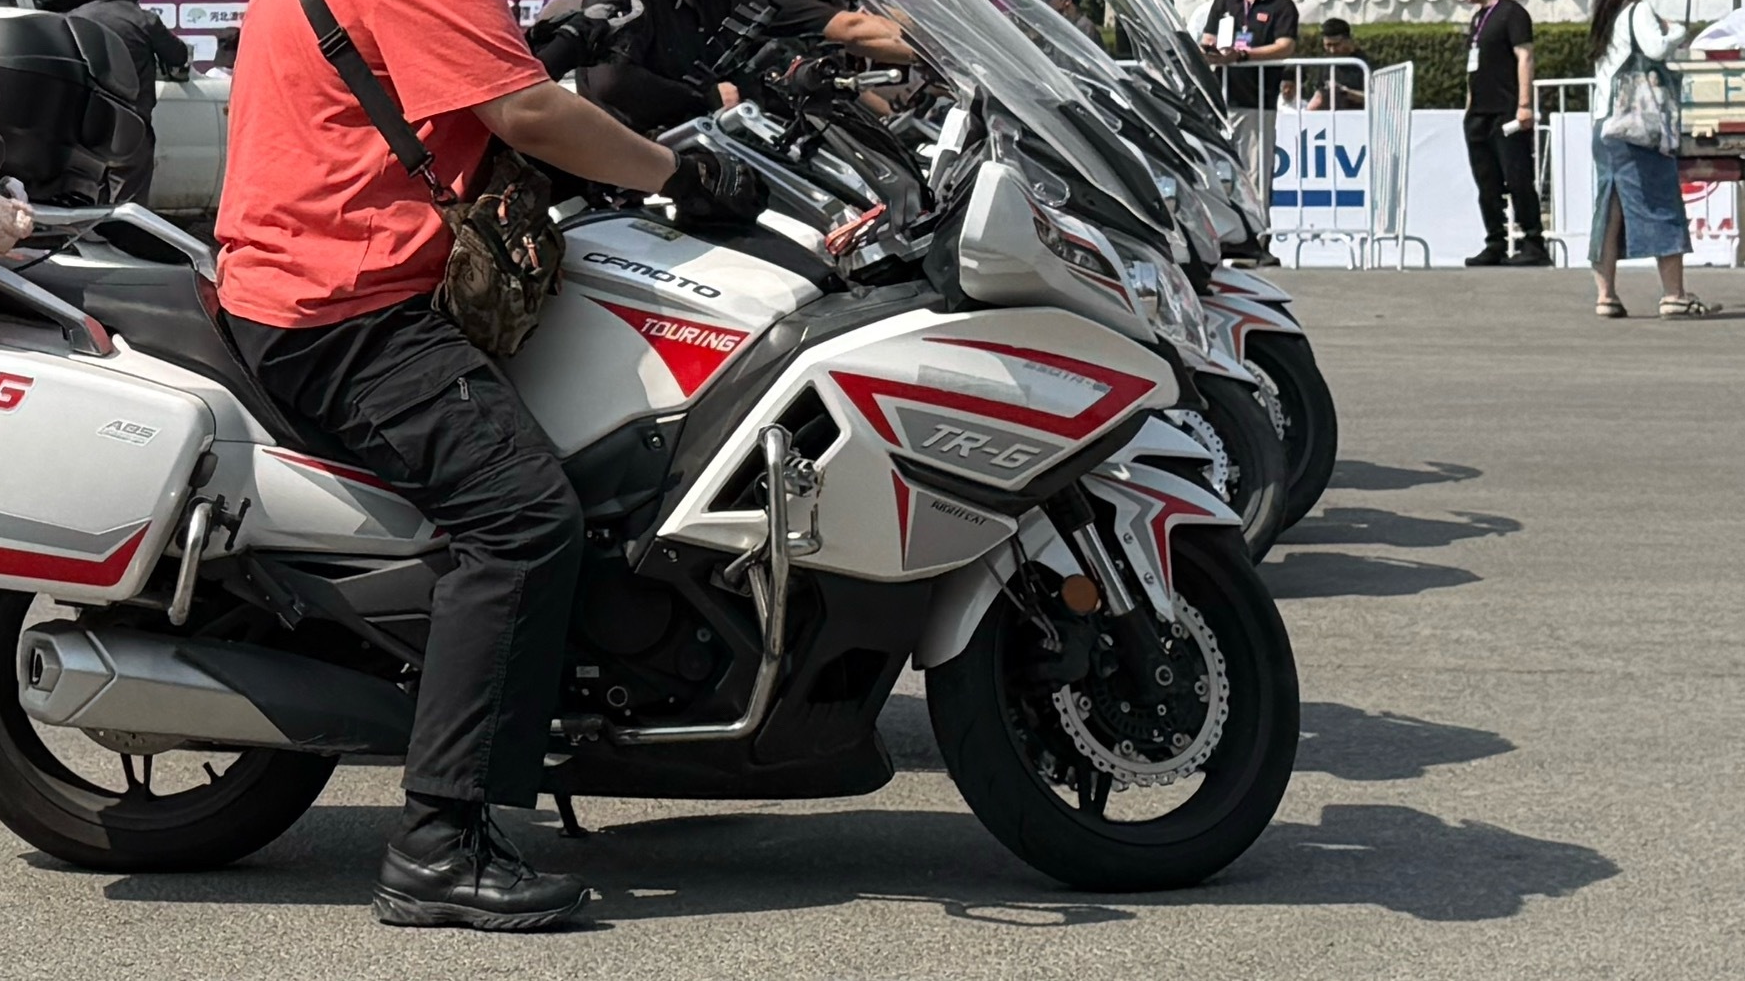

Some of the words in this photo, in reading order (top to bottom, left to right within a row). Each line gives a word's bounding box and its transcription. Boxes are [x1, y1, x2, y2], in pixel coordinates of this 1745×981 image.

[582, 252, 722, 299] CFMOTO
[641, 317, 741, 353] TOURING
[105, 419, 157, 439] ABS
[922, 423, 1042, 469] TR-G
